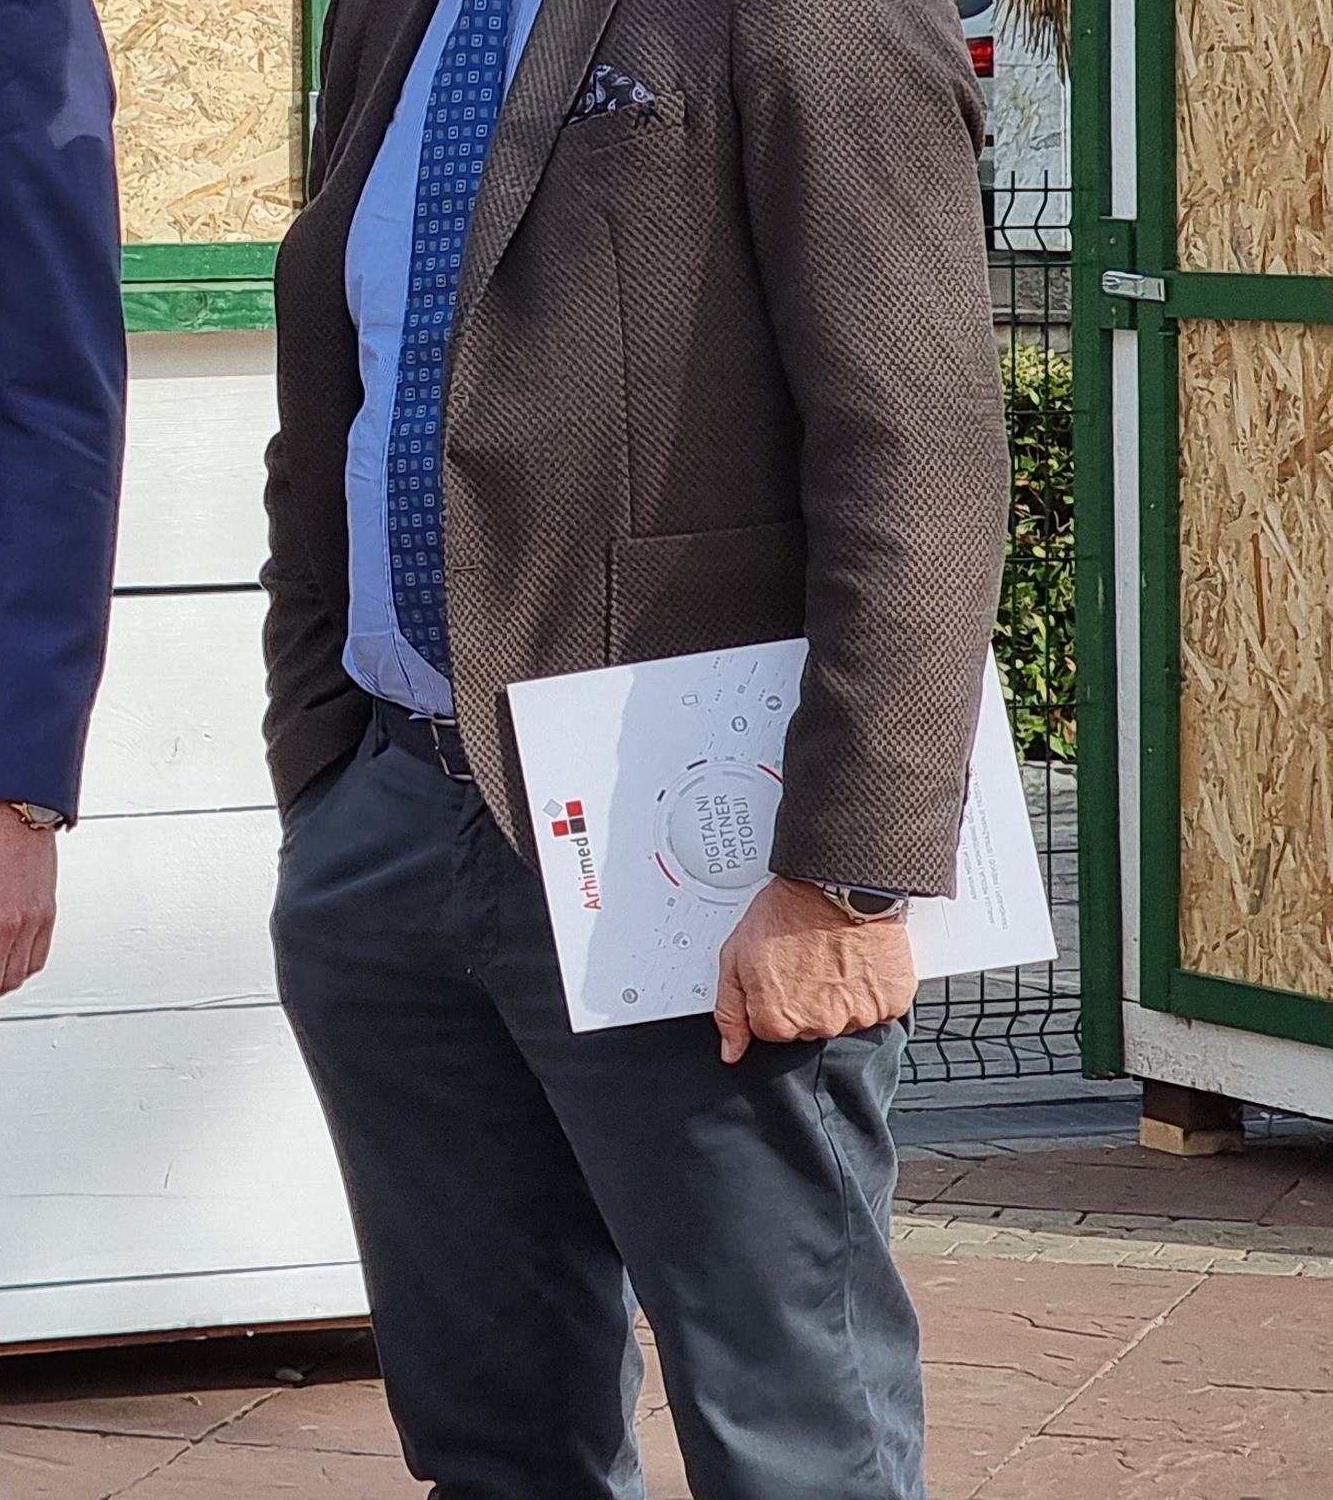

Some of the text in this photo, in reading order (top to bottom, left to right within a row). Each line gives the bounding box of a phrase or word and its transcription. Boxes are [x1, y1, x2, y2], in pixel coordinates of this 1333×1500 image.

[696, 795, 723, 874] DIGITALNI
[714, 794, 740, 870] PARTNER
[733, 797, 757, 862] ISTORIJI
[570, 837, 602, 910] Arhimed
